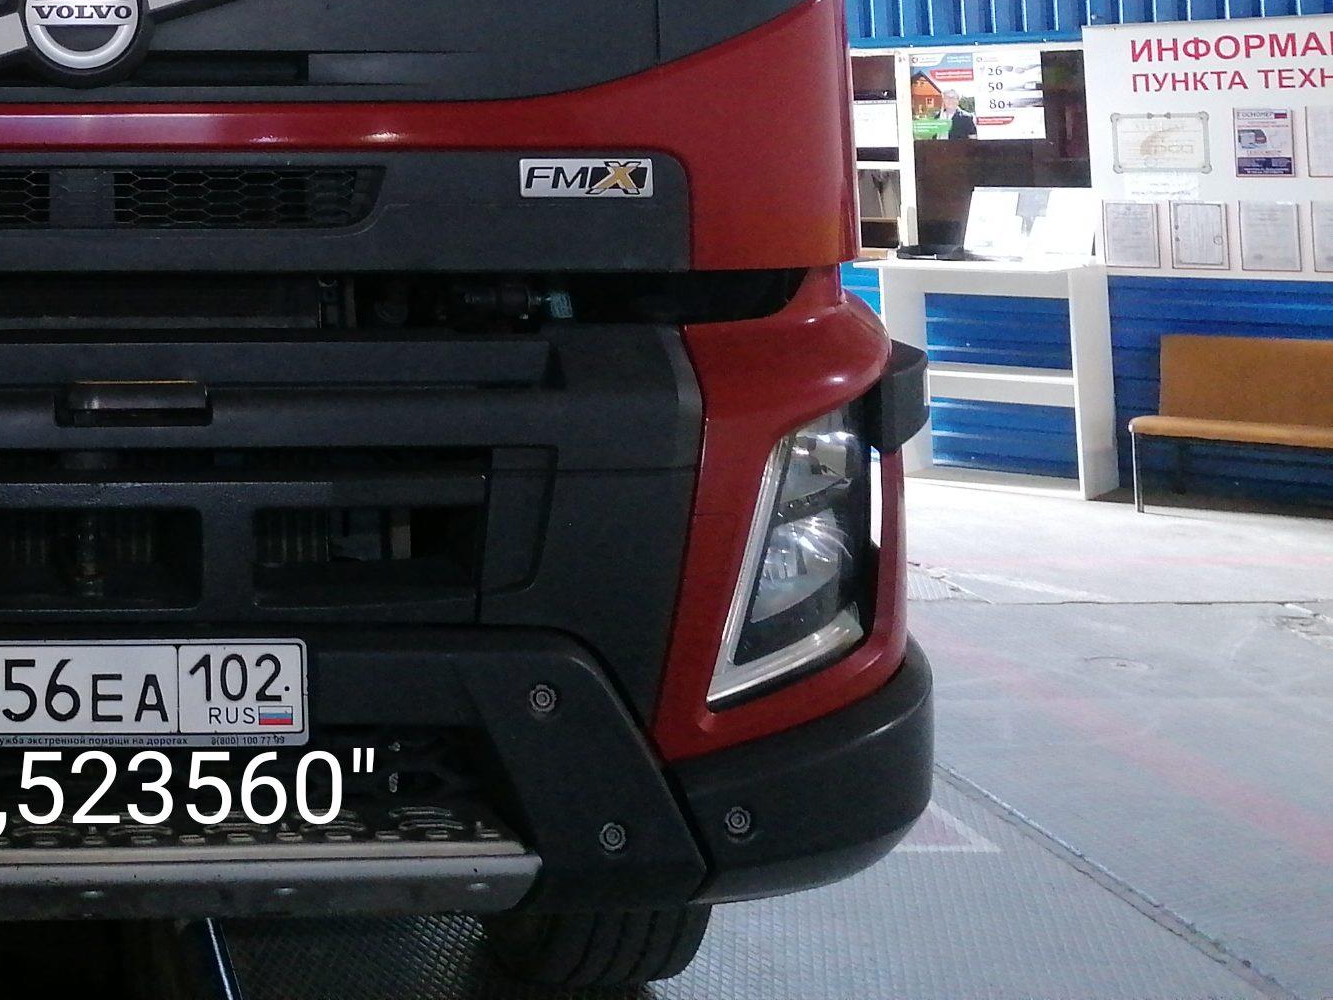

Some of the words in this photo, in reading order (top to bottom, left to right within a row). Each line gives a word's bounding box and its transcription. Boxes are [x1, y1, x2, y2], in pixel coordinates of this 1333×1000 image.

[31, 5, 133, 20] VOLVO
[1130, 31, 1333, 62] ИНФОРМА
[1131, 70, 1249, 92] ПУНКТА
[525, 161, 642, 194] FMX
[188, 653, 283, 702] 102
[208, 706, 256, 725] RUS
[132, 737, 144, 745] на
